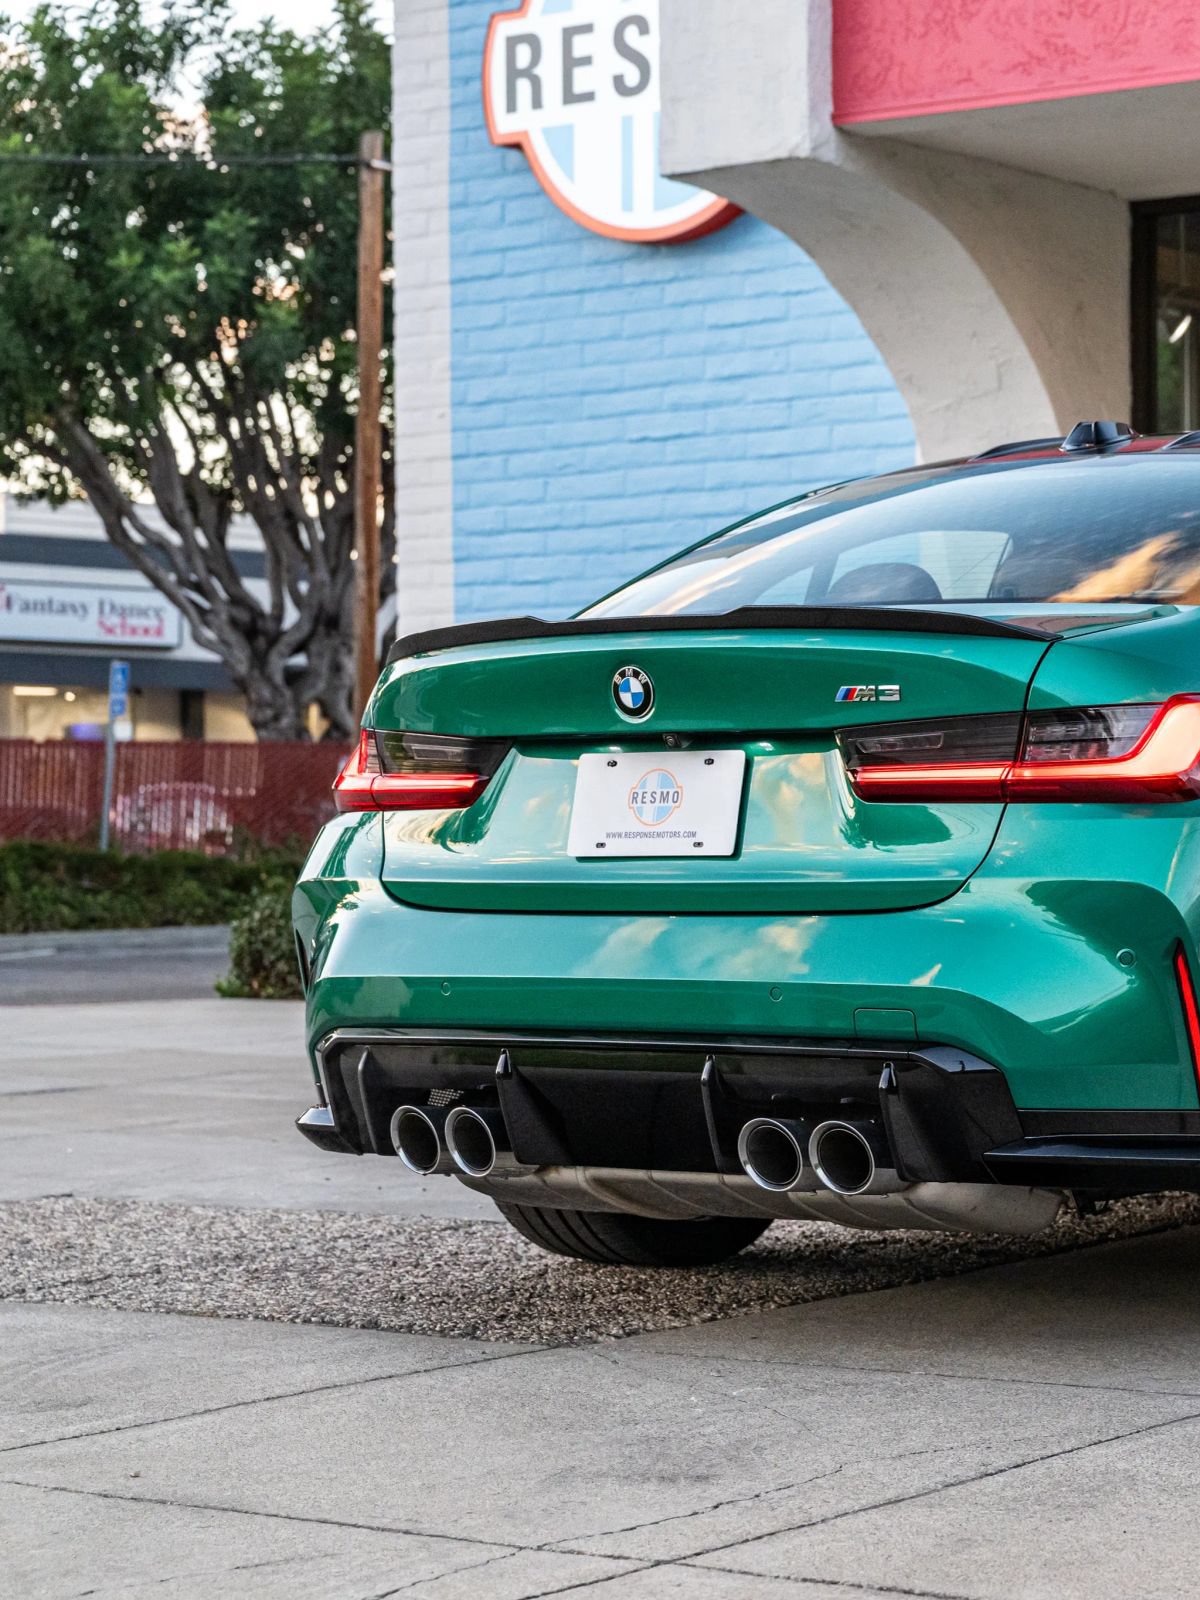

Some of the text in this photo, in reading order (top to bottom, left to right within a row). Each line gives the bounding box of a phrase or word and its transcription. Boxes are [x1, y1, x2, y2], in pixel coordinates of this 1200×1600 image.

[505, 14, 652, 115] RES
[97, 613, 165, 637] School
[614, 668, 648, 685] BMW
[835, 684, 900, 702] M3
[631, 790, 680, 804] RESMO
[605, 830, 697, 840] WWW.RESPONSEMOTORS.COM
